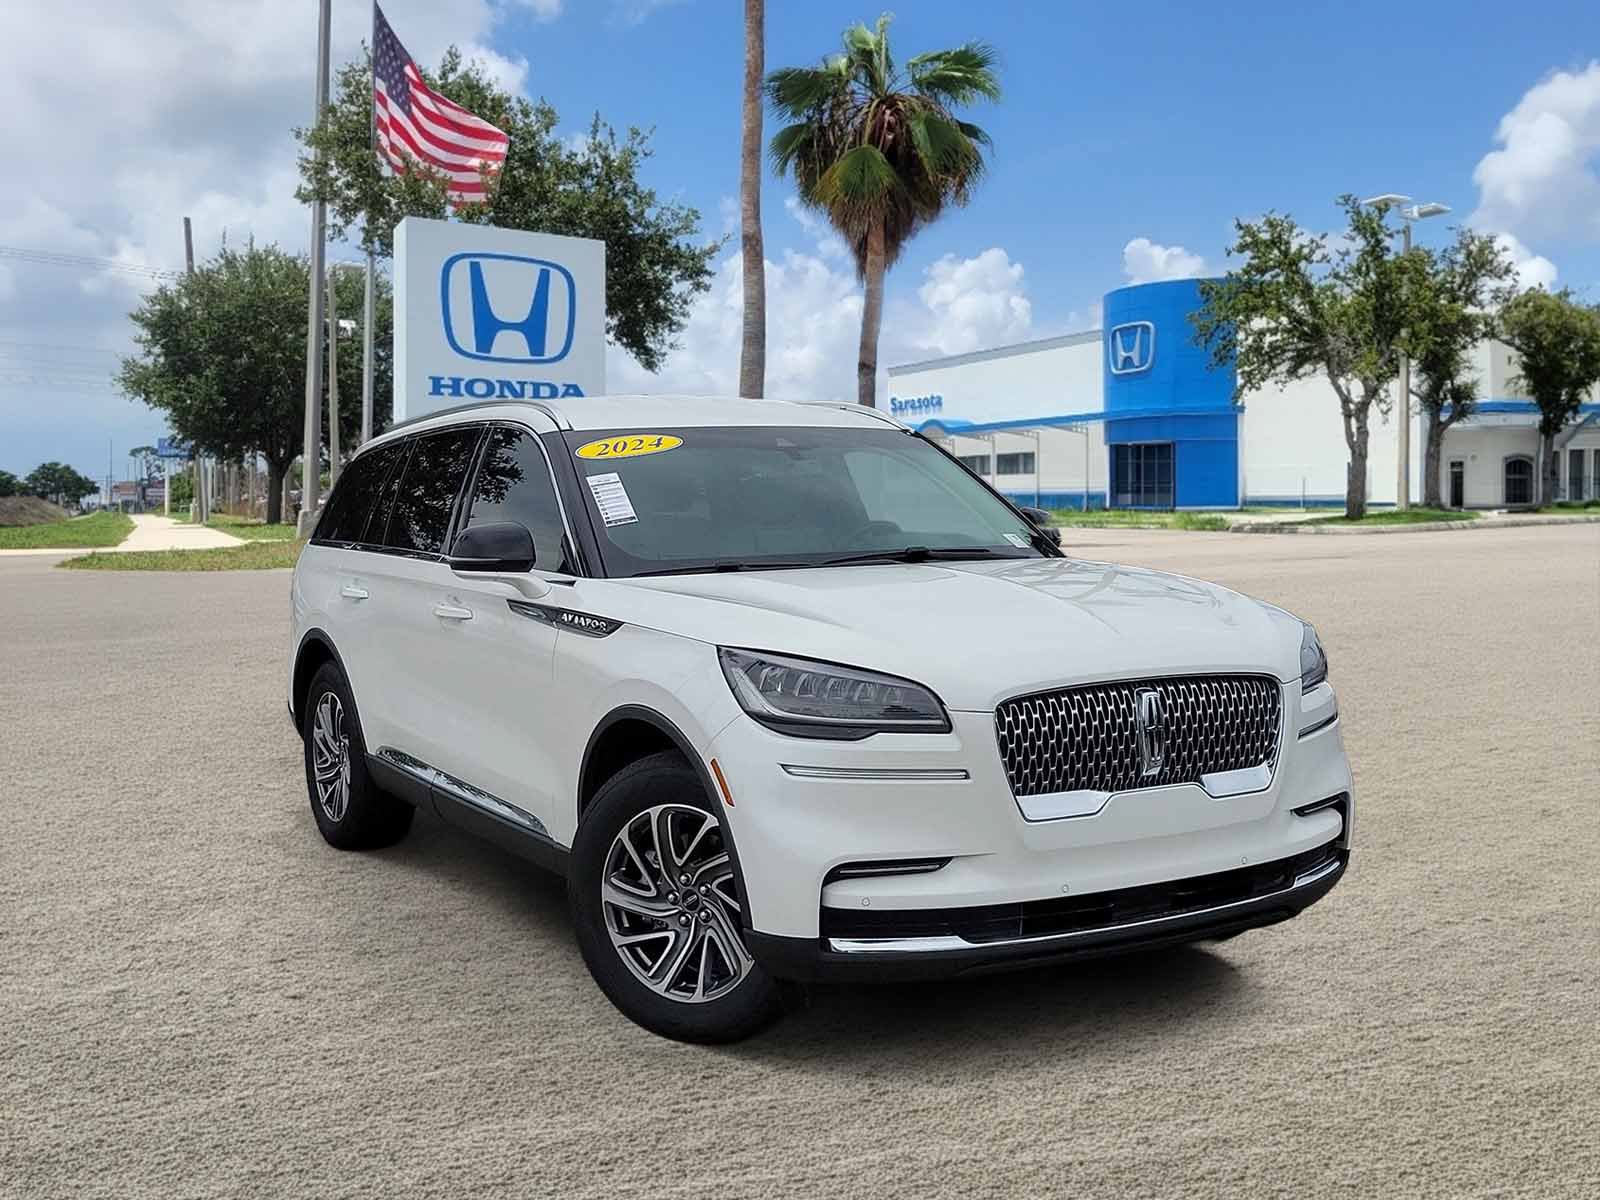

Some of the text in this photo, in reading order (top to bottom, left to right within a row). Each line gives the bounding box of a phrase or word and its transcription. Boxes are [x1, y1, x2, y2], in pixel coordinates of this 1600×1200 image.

[428, 376, 585, 399] HONDA
[890, 394, 943, 411] Sarasota
[596, 436, 664, 456] 2024
